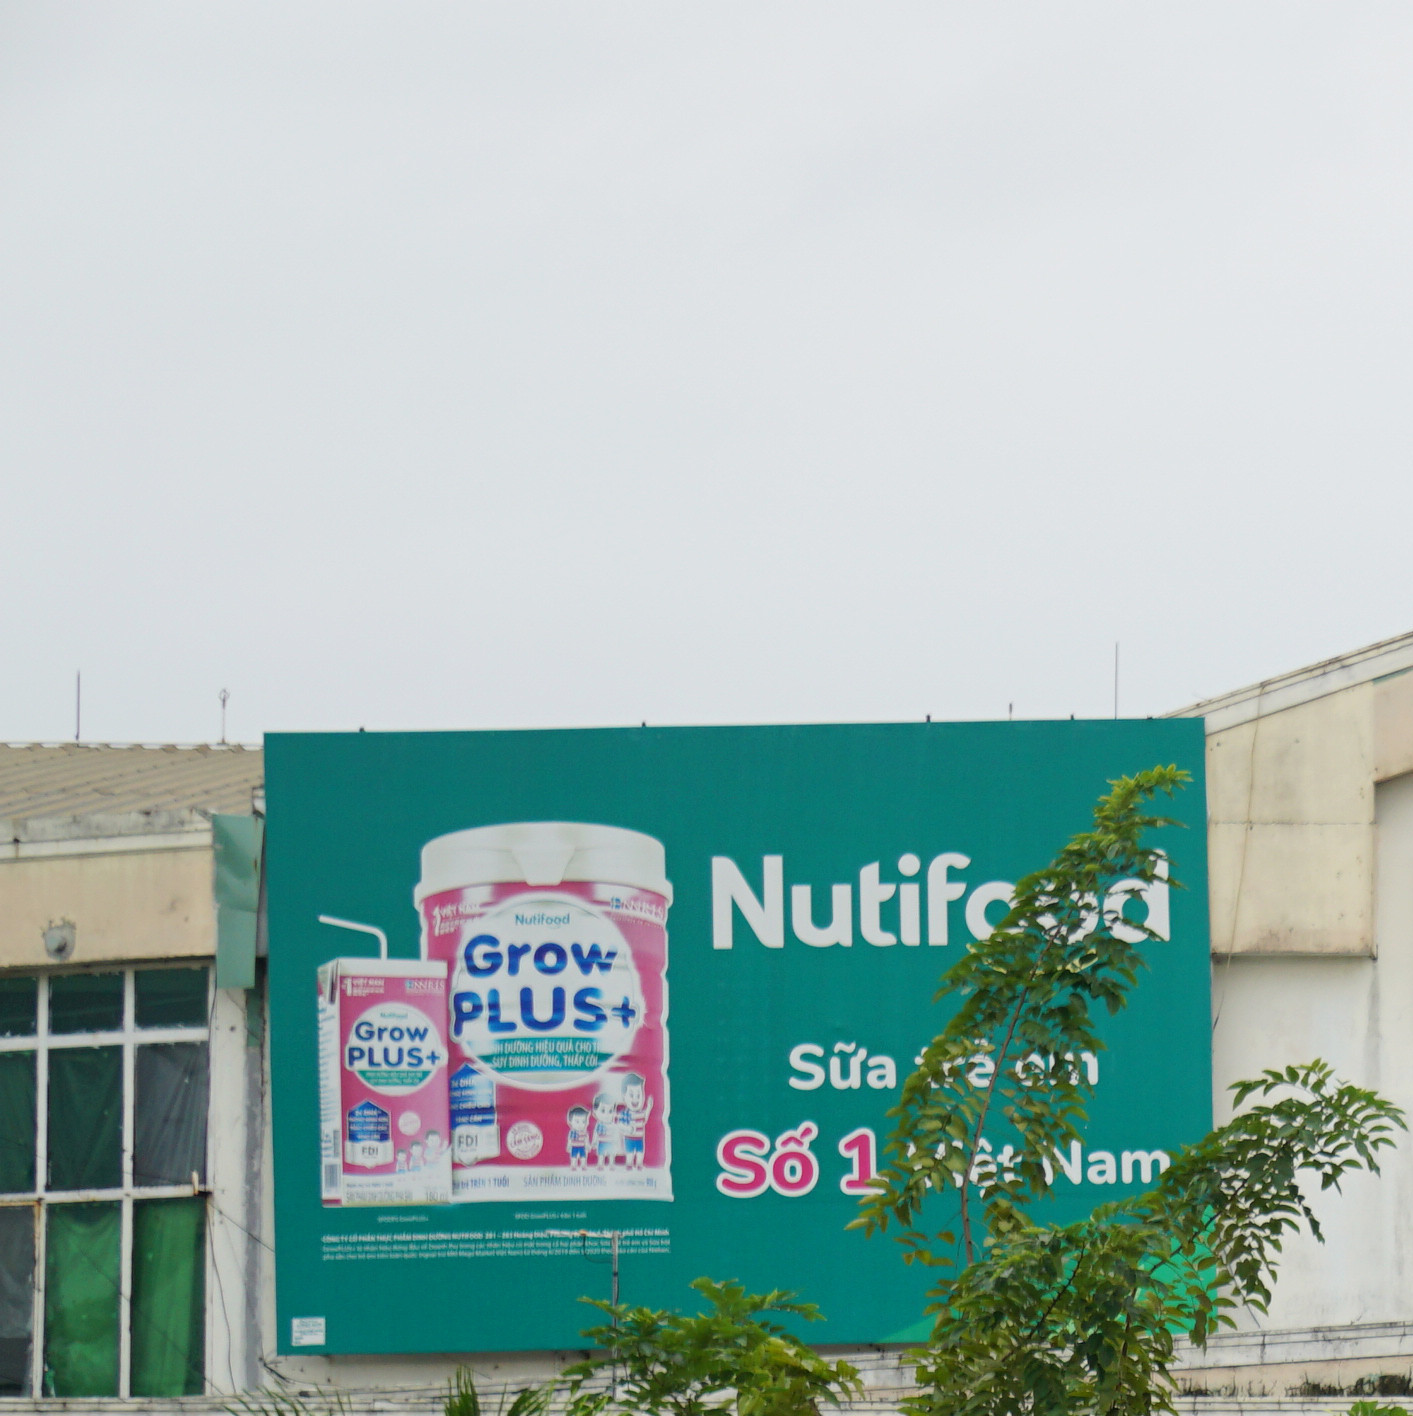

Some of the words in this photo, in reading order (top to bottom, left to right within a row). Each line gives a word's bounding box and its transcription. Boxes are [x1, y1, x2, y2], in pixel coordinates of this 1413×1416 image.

[515, 912, 571, 929] Nutifood
[463, 934, 618, 978] Grow
[355, 1021, 429, 1042] Grow
[453, 986, 637, 1037] PLUS+
[348, 1046, 441, 1068] PLUS+
[789, 1040, 897, 1091] Sữa
[716, 1121, 820, 1198] Số
[838, 1127, 885, 1198] 1
[1041, 1140, 1171, 1186] Nam
